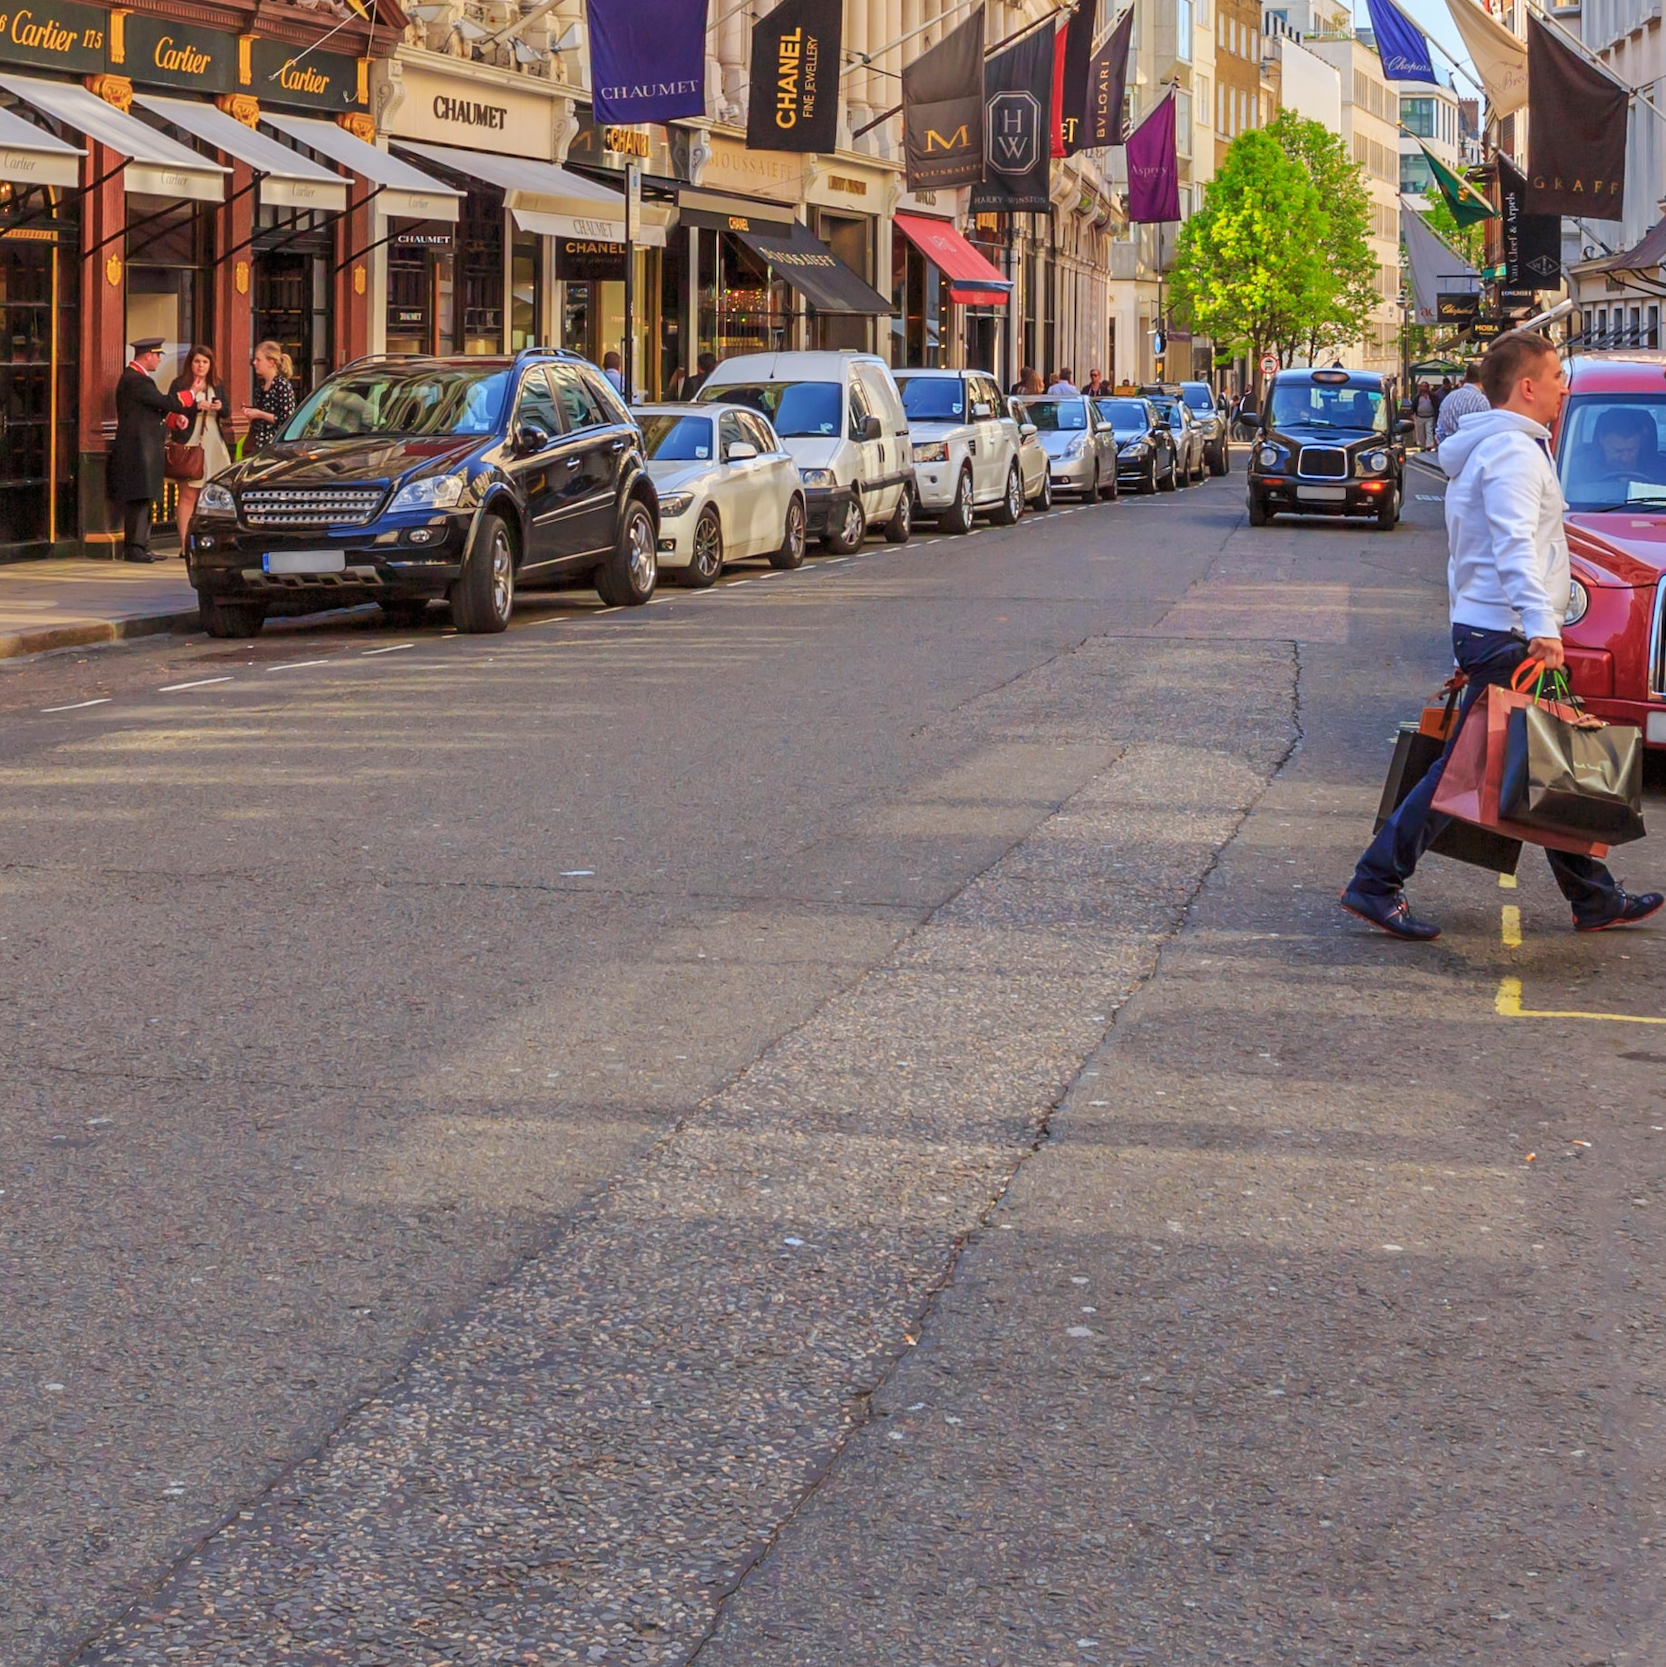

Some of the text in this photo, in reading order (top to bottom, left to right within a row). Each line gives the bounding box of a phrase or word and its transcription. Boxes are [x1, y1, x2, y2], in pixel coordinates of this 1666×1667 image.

[11, 9, 77, 53] Cartier
[82, 29, 103, 50] 175
[153, 36, 211, 75] Cartier
[1387, 55, 1432, 74] Chopar
[280, 58, 330, 95] Cartier
[775, 26, 802, 130] CHANEL
[802, 34, 819, 119] FINE JEWELLERY
[600, 79, 699, 101] CHAUMET
[1096, 60, 1110, 138] BVLGARI
[433, 94, 508, 131] CHAUMET
[1004, 109, 1022, 133] H
[923, 124, 972, 153] M
[997, 136, 1029, 159] W
[4, 150, 35, 173] Cartier
[709, 151, 794, 180] MOUSSAIEFF
[1132, 164, 1168, 177] Asprey
[160, 168, 188, 188] Cartier
[1534, 176, 1619, 194] GRAFF
[291, 181, 315, 200] Cartier
[974, 196, 1004, 205] HARRY
[397, 236, 451, 244] CHAUMET
[573, 219, 613, 238] CHAUMET
[565, 242, 626, 254] CHANEL
